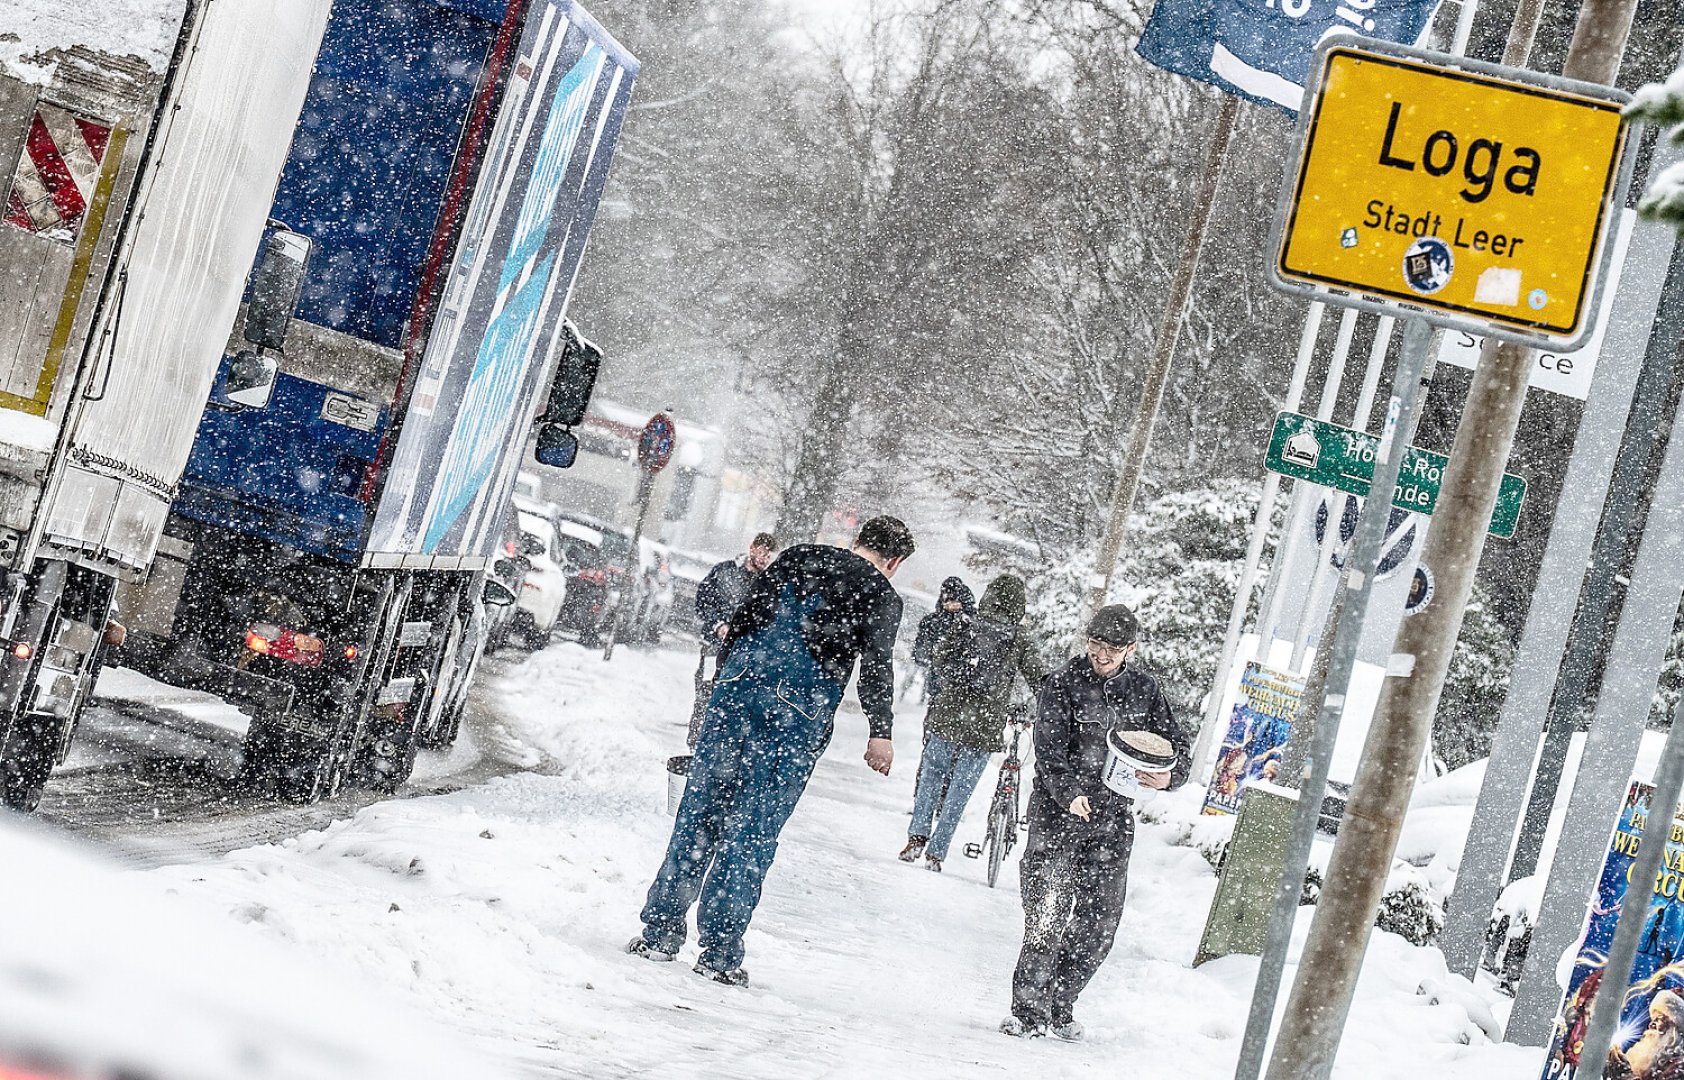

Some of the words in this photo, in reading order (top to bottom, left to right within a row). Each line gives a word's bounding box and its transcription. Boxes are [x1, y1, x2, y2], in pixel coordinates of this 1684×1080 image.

[1379, 102, 1541, 203] Loga
[1363, 200, 1441, 237] Stadt
[1453, 218, 1524, 257] Leer
[1392, 485, 1429, 506] nde
